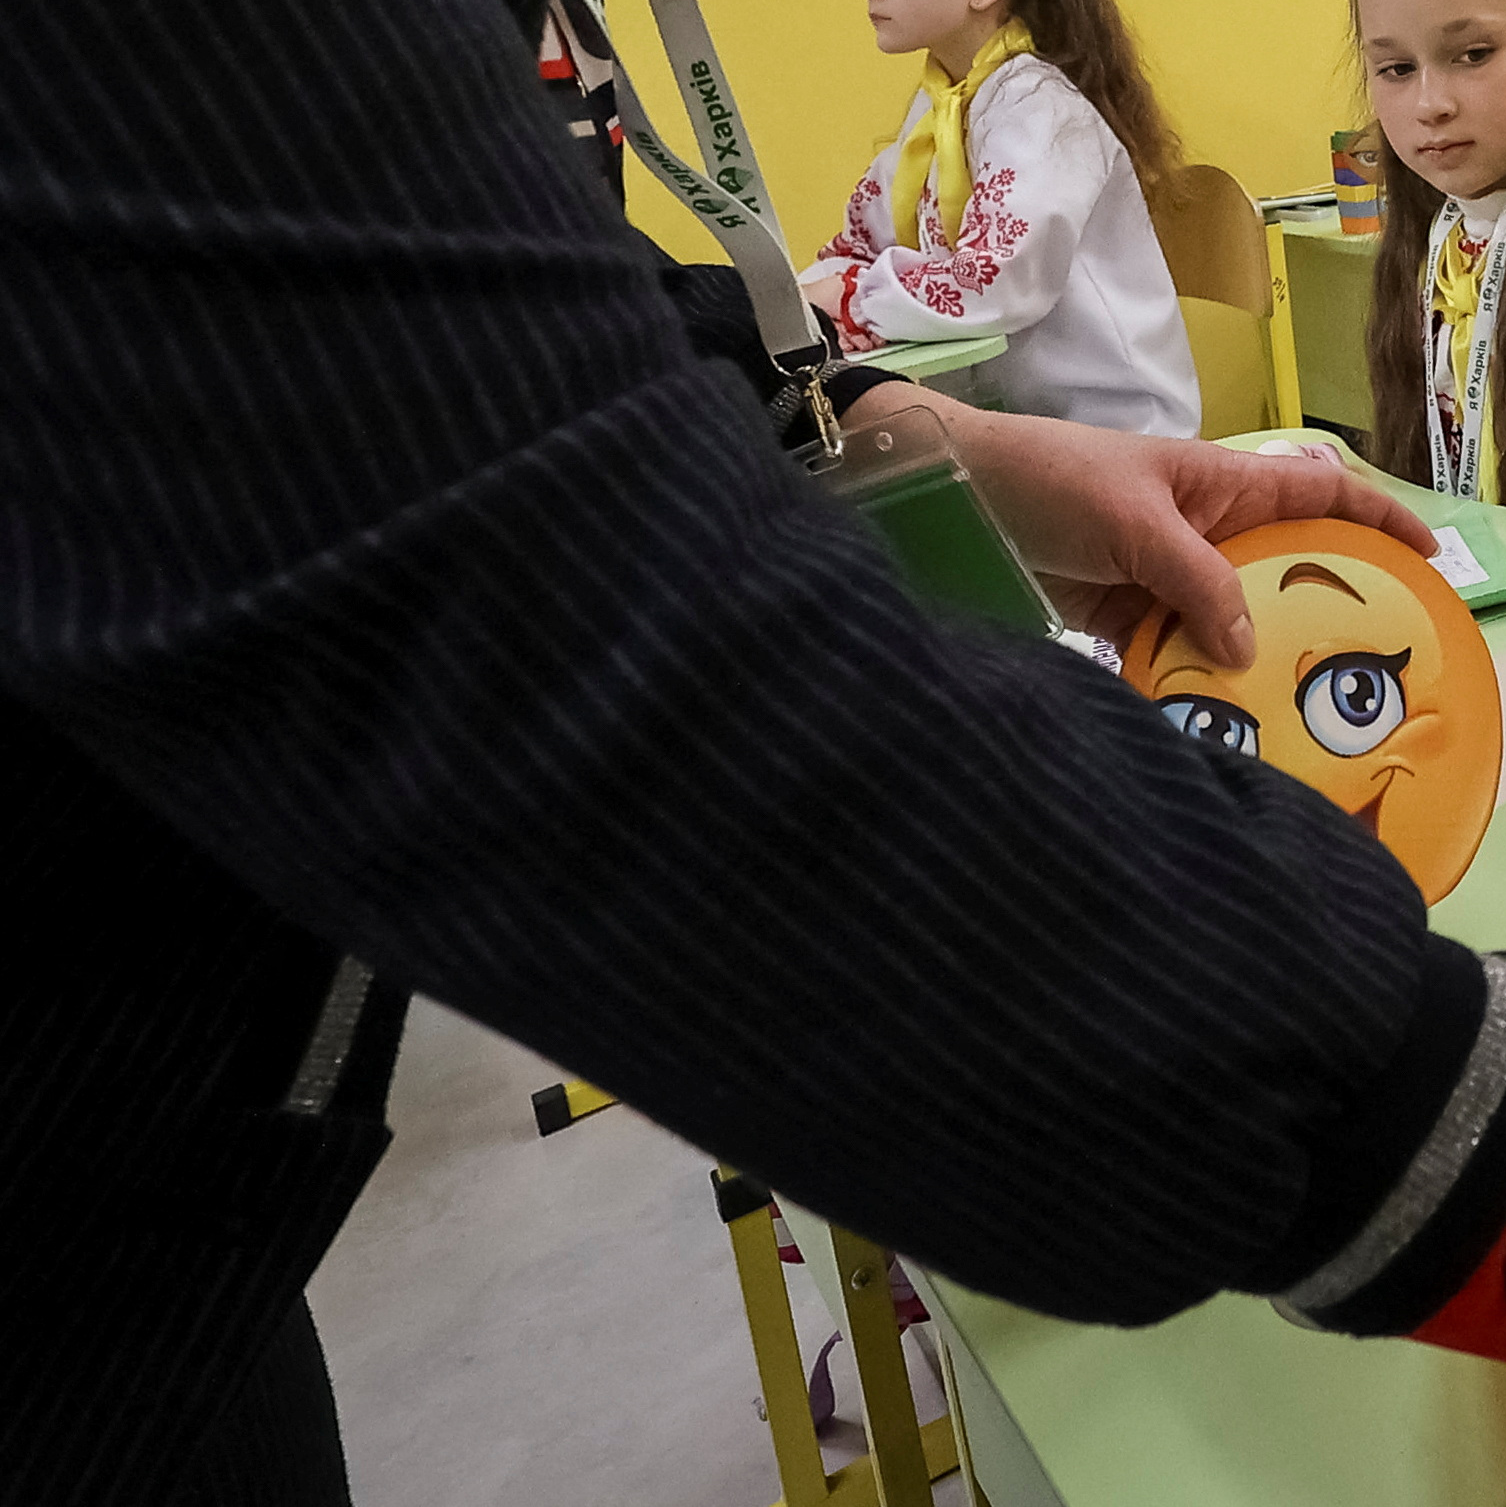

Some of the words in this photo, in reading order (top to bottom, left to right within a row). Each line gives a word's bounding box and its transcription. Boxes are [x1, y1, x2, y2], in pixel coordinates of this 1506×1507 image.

[690, 60, 742, 162] Харків
[635, 130, 711, 196] Харків
[715, 214, 748, 229] Я
[1444, 214, 1455, 223] Я
[1487, 241, 1506, 287] Харків
[1483, 302, 1494, 313] Я
[1471, 340, 1488, 385] Харків
[1469, 401, 1479, 411] Я
[1434, 434, 1447, 479] Харків
[1463, 438, 1476, 483] Харків
